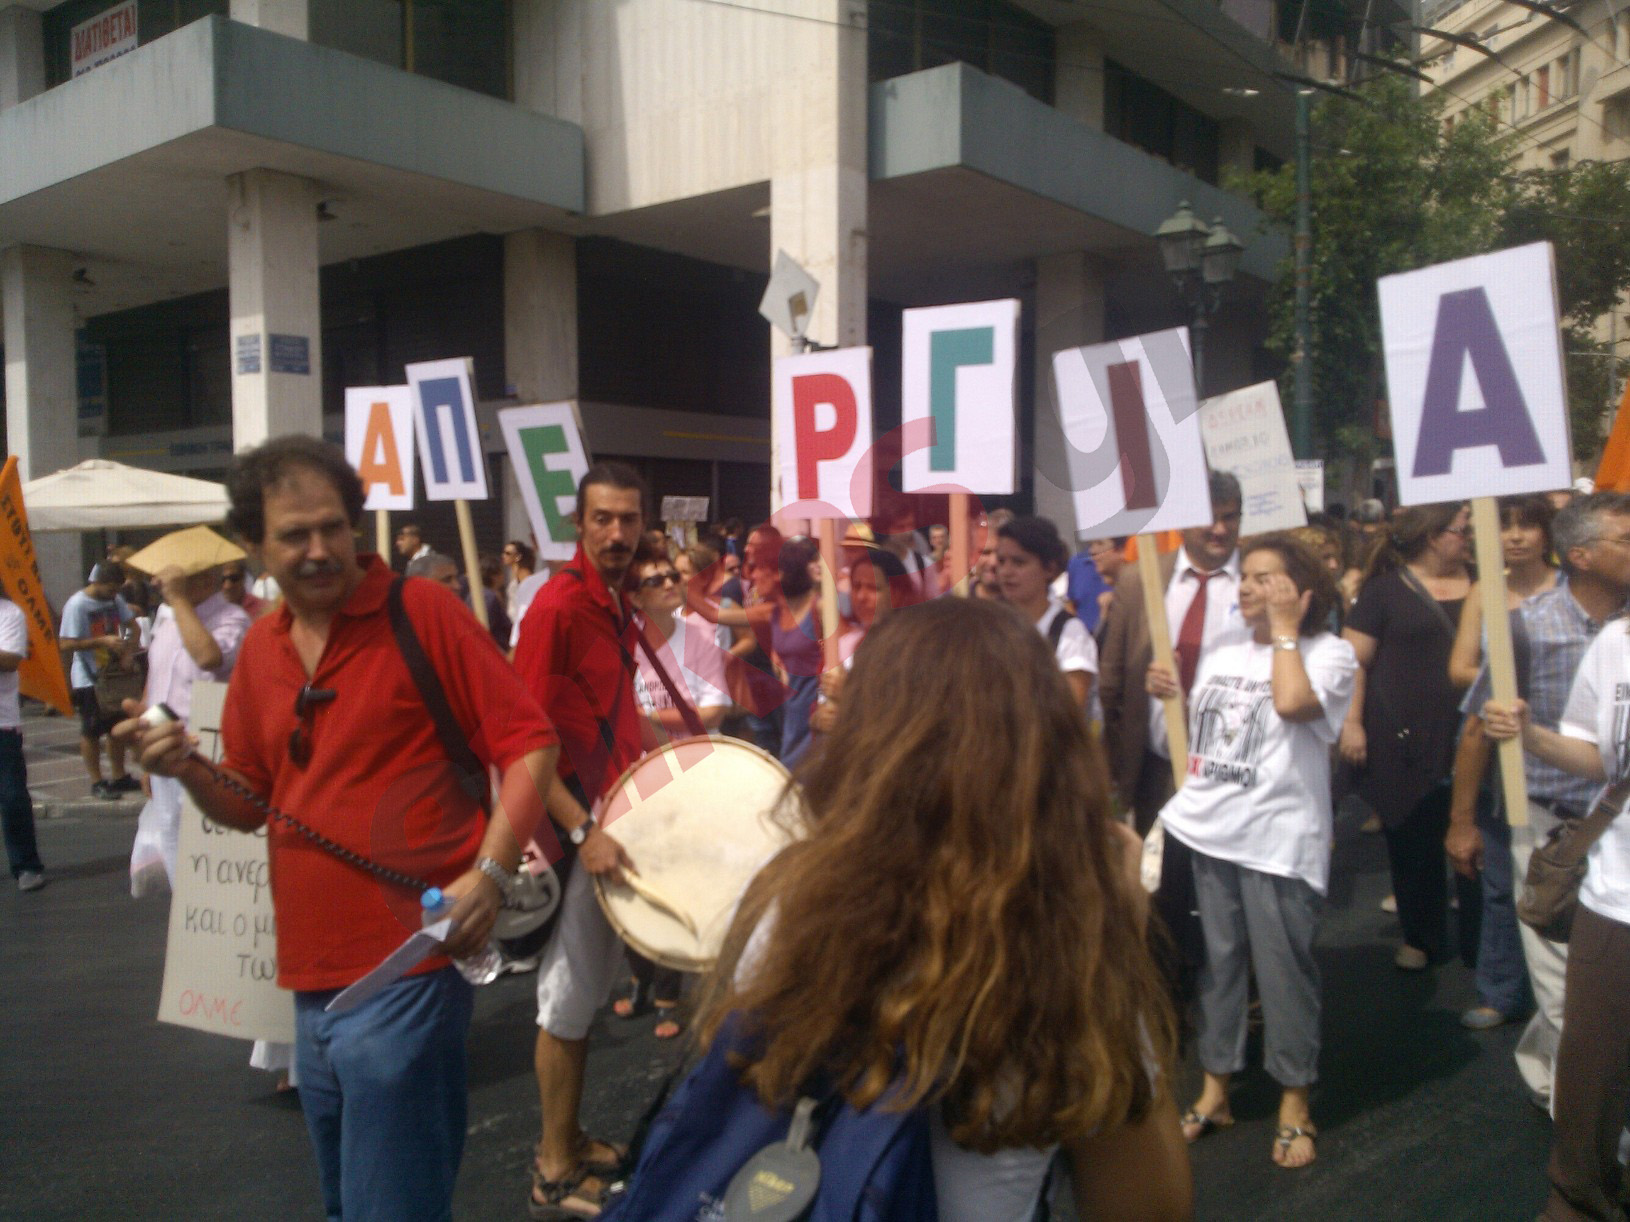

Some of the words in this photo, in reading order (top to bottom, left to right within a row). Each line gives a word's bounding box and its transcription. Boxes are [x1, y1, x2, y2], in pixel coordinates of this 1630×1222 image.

[418, 377, 476, 483] Π
[791, 373, 858, 499] Ρ
[930, 326, 994, 473] Γ
[1412, 286, 1548, 478] Α
[357, 402, 405, 496] Α
[518, 424, 580, 542] Ε
